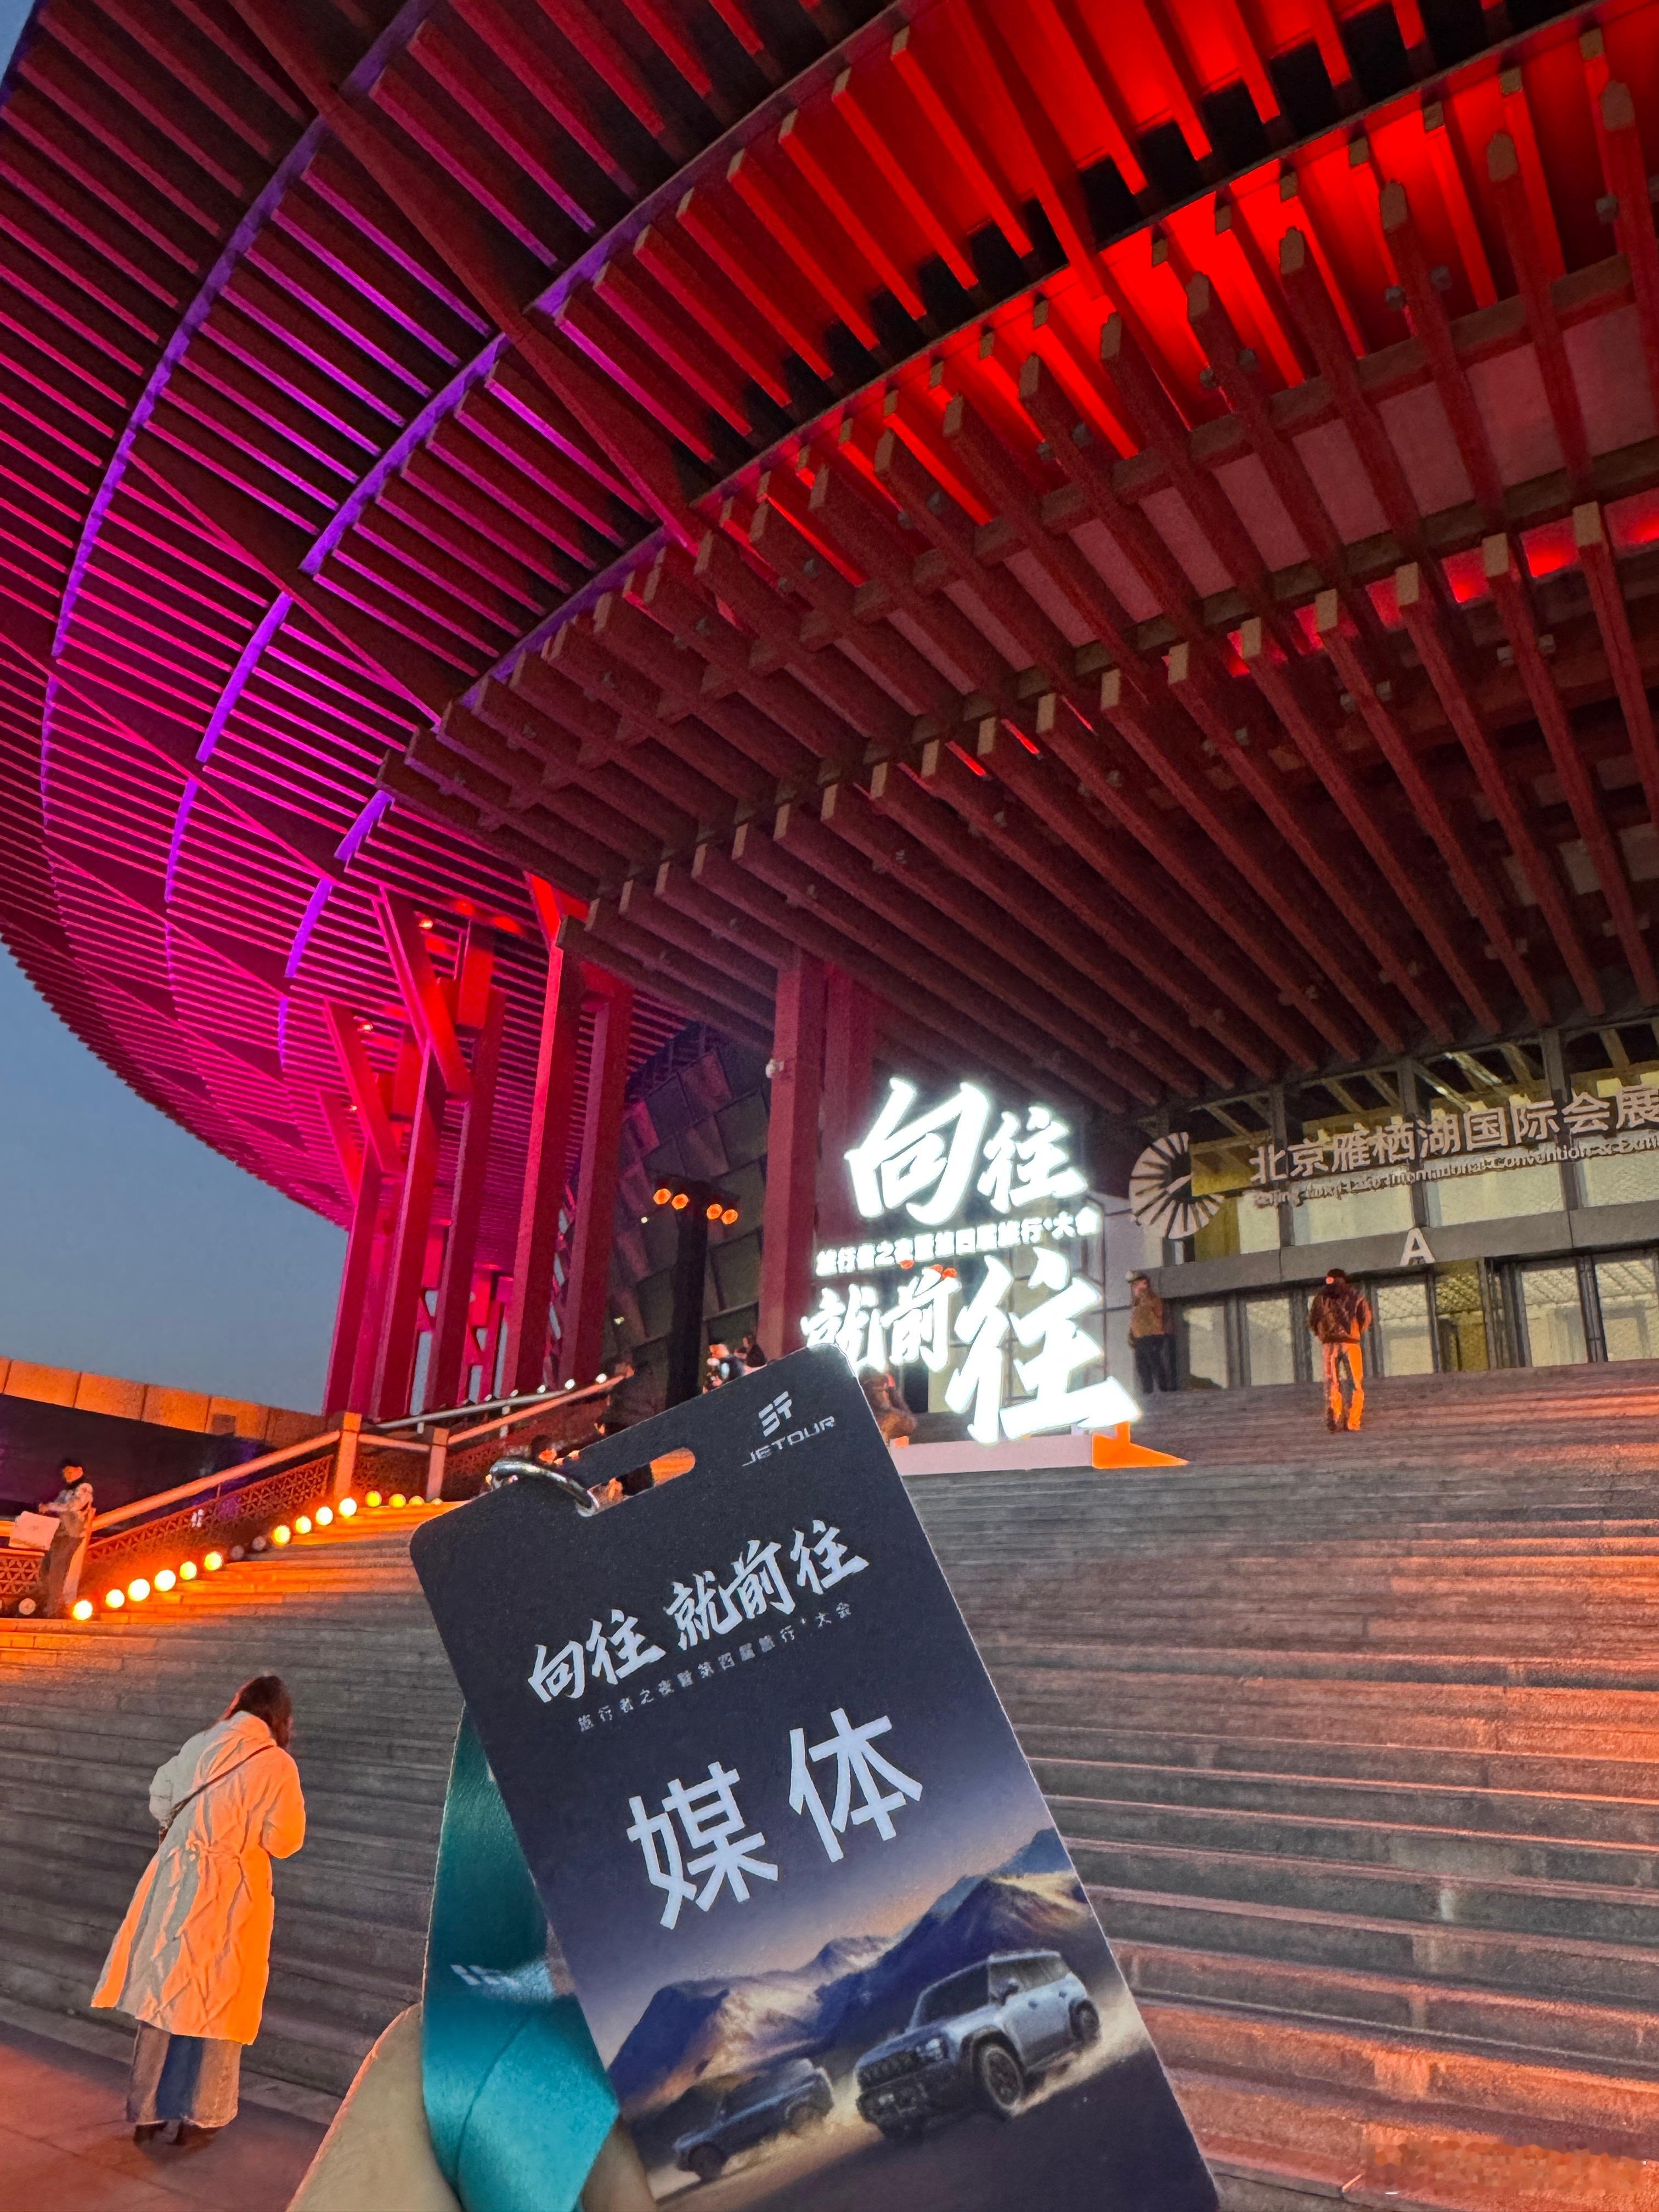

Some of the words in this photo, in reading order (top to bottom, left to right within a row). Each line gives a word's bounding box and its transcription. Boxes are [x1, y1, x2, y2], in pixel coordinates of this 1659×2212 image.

[843, 1077, 1088, 1226] 向往
[1249, 1084, 1659, 1184] 北京雁栖湖国际会展
[1400, 1227, 1435, 1266] A
[800, 1246, 1142, 1444] 就前往
[742, 1416, 836, 1466] JETOUR
[528, 1609, 667, 1703] 向往
[662, 1519, 870, 1651] 就前往
[627, 1702, 923, 1930] 媒体
